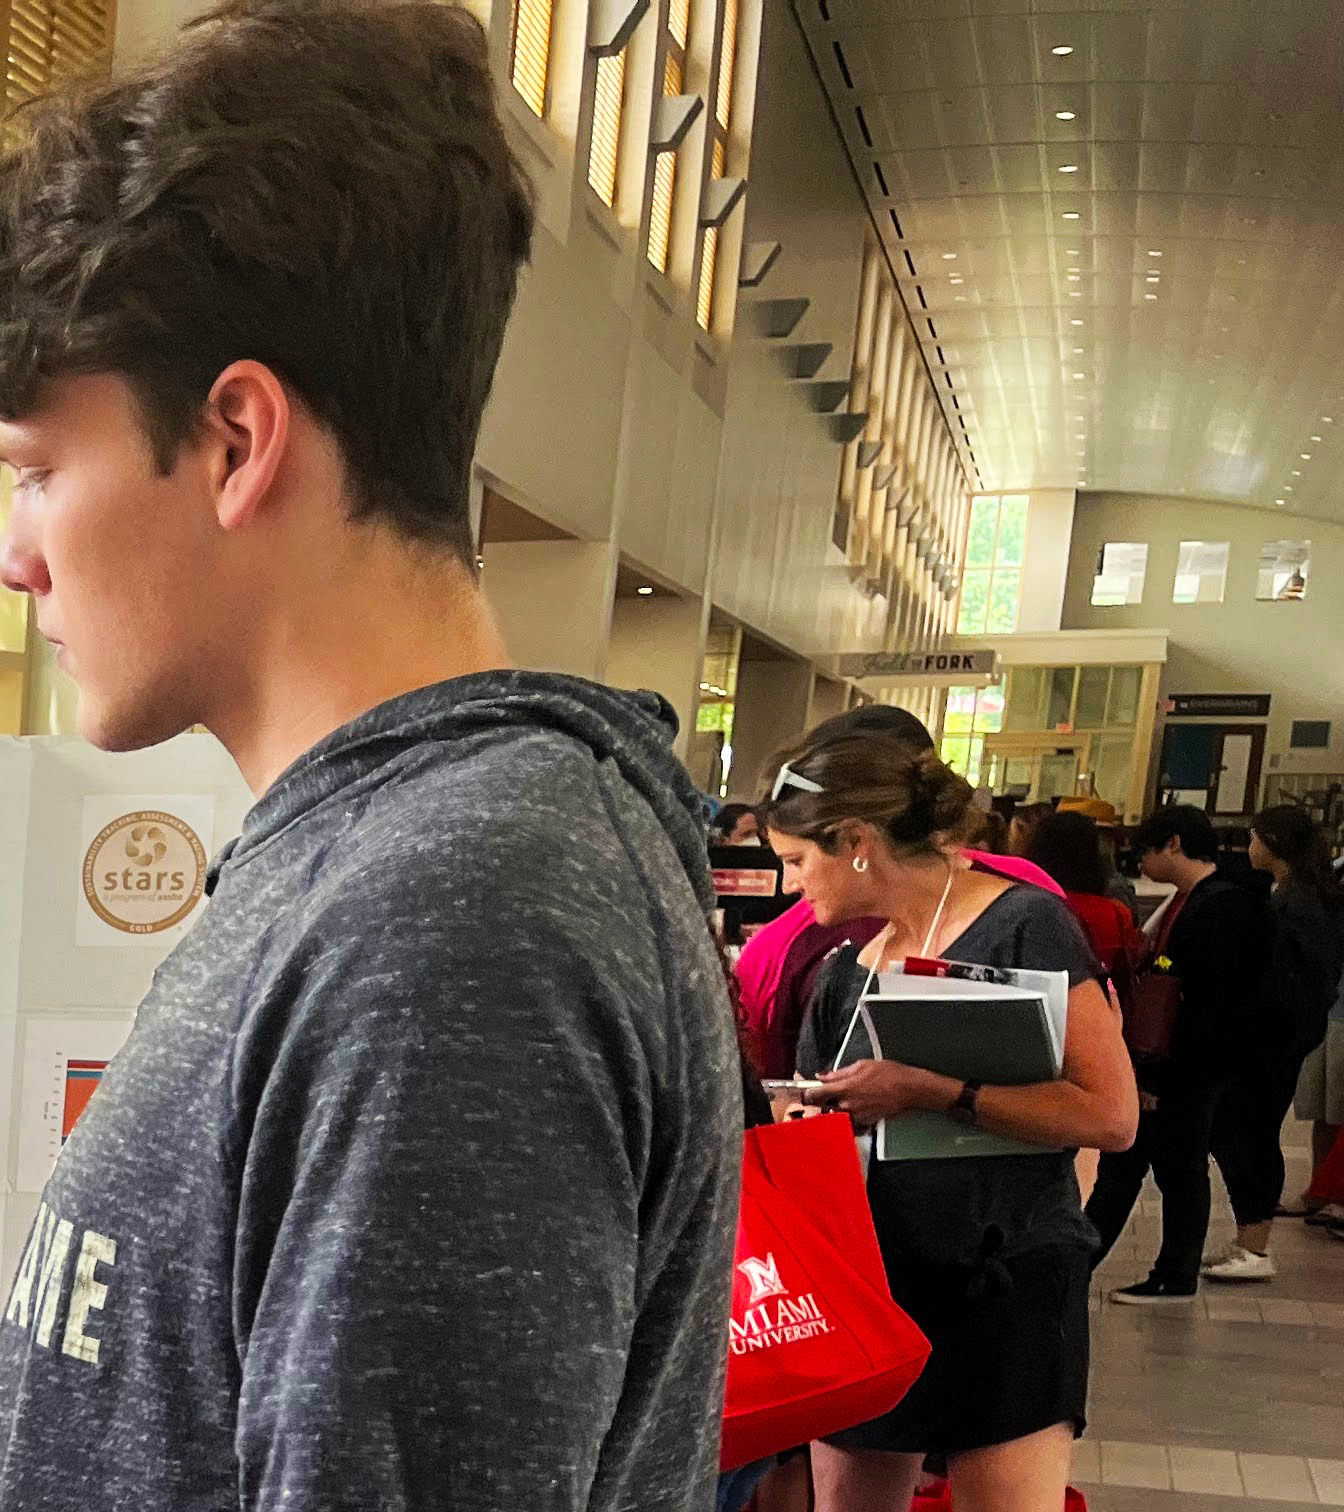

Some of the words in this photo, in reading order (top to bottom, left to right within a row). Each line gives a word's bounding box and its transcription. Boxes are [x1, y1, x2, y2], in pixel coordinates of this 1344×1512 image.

[924, 655, 975, 670] FORK
[103, 867, 185, 891] stars
[129, 924, 153, 932] GOLD
[728, 1293, 824, 1340] MIAMI
[730, 1318, 830, 1355] UNIVERSITY
